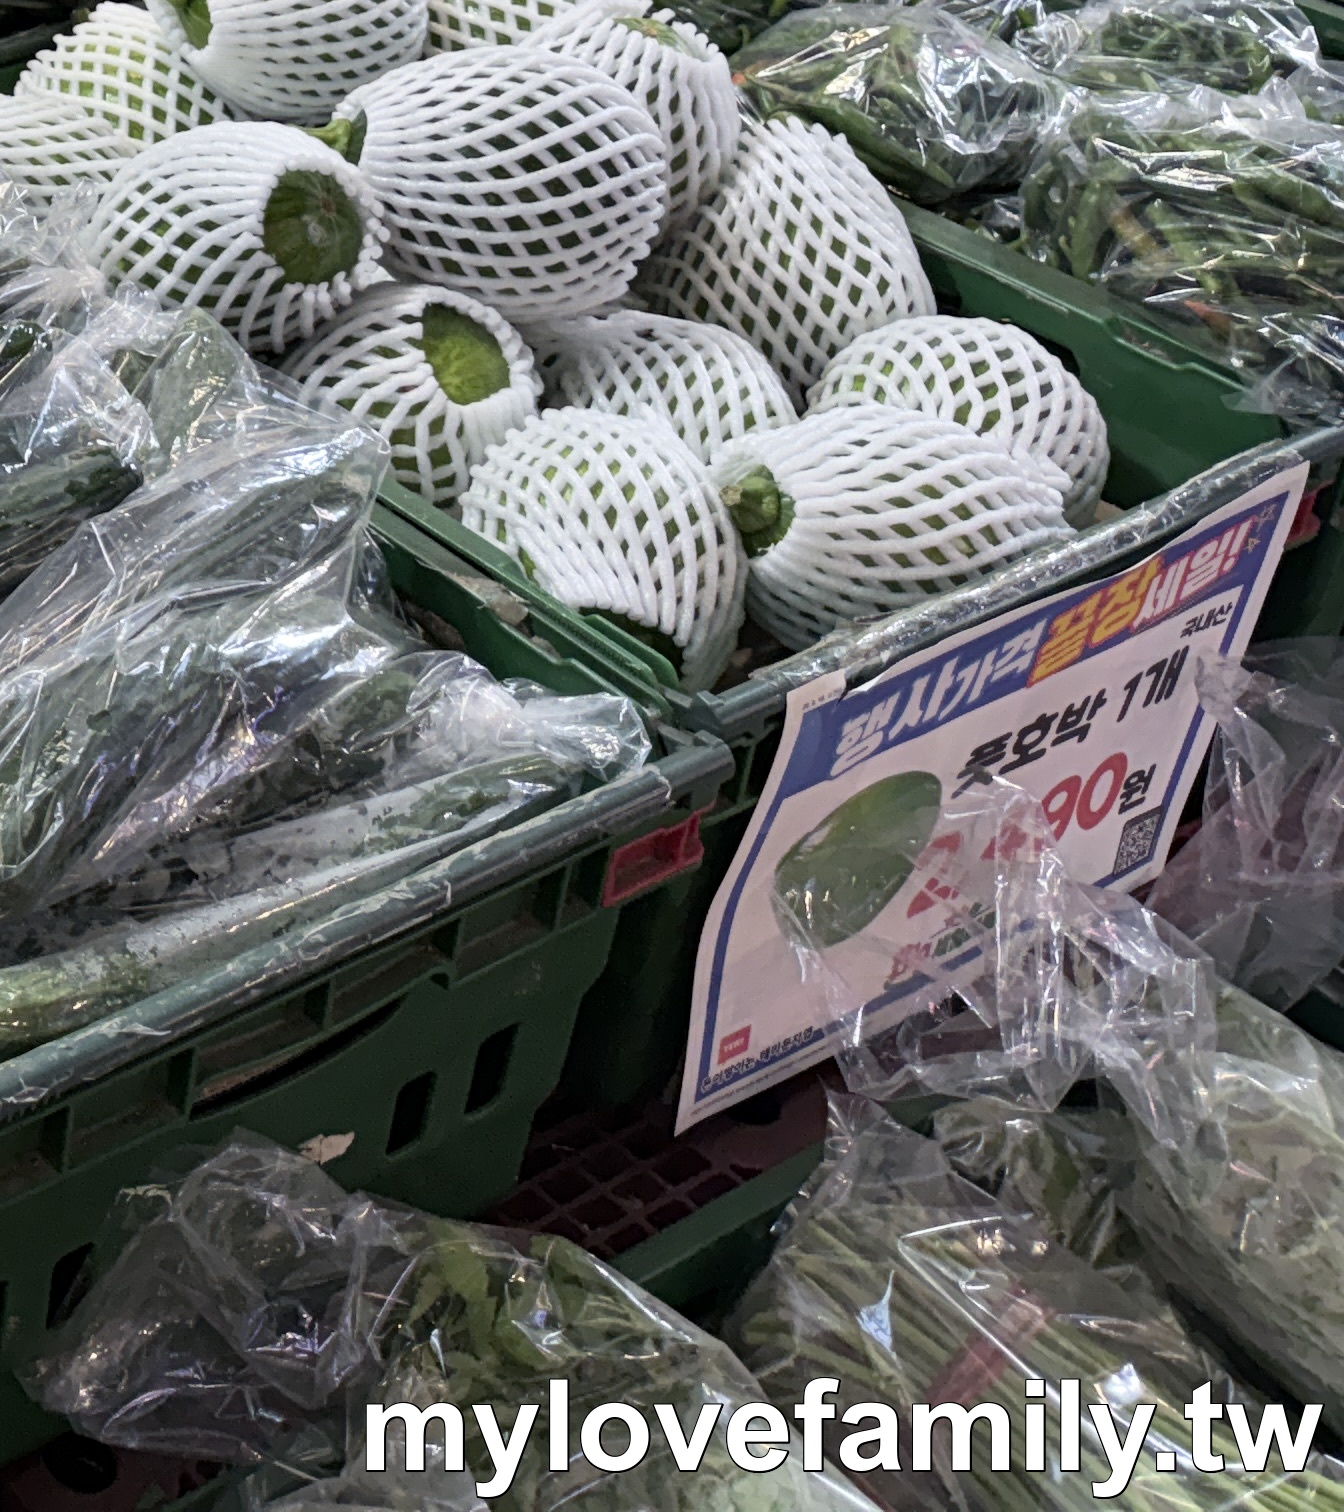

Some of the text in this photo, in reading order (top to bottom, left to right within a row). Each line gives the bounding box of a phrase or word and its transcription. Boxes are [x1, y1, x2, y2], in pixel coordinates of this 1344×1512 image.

[1179, 603, 1234, 640] 국내산
[831, 617, 1049, 779] 행사가격
[1115, 643, 1188, 725] 1개
